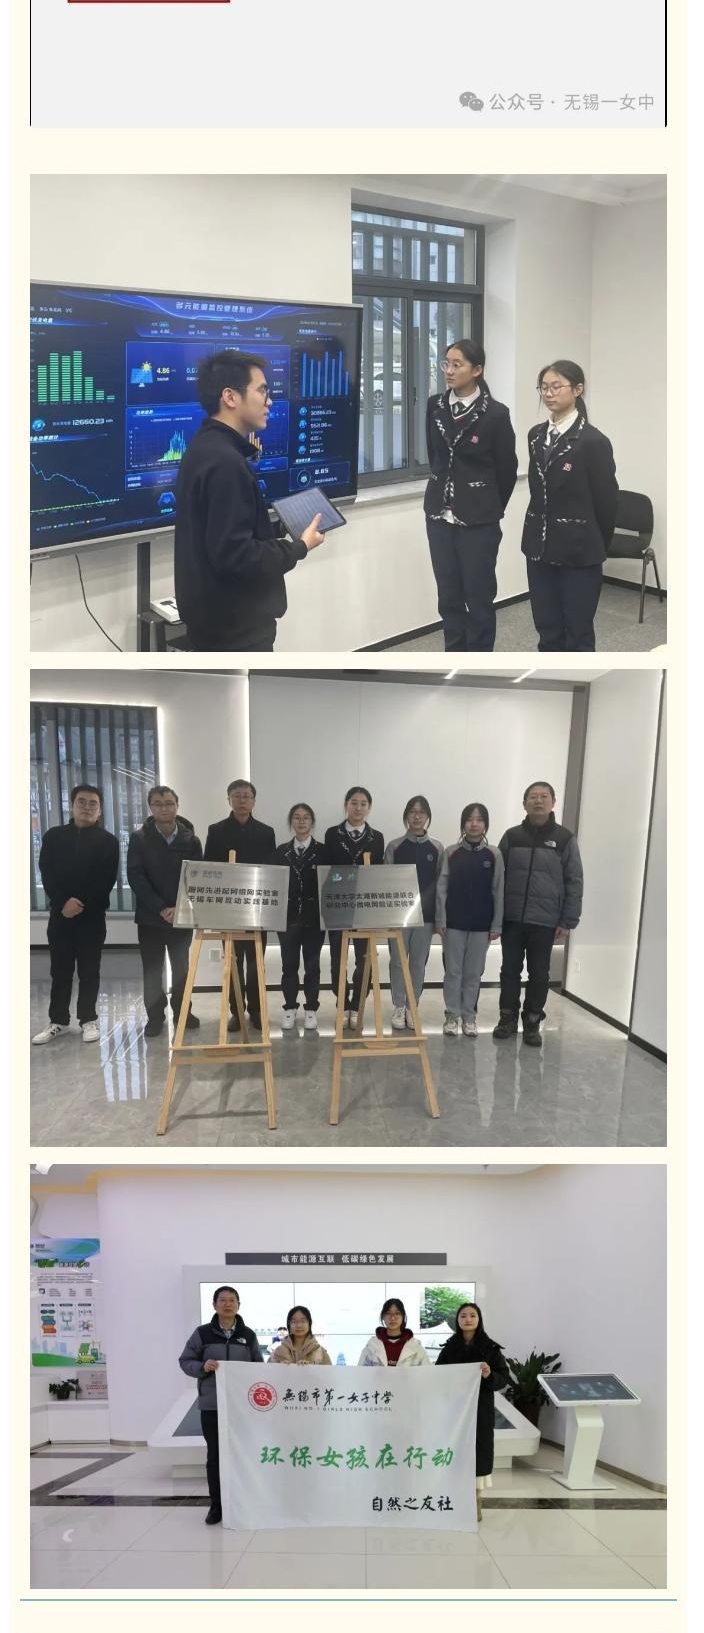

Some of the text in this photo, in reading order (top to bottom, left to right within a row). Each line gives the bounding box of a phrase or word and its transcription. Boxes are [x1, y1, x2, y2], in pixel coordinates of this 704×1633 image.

[281, 1254, 395, 1264] 城市能源互联 低碳绿色发展
[260, 1444, 454, 1470] 环保女孩在行动
[372, 1496, 453, 1512] 自然之友社
